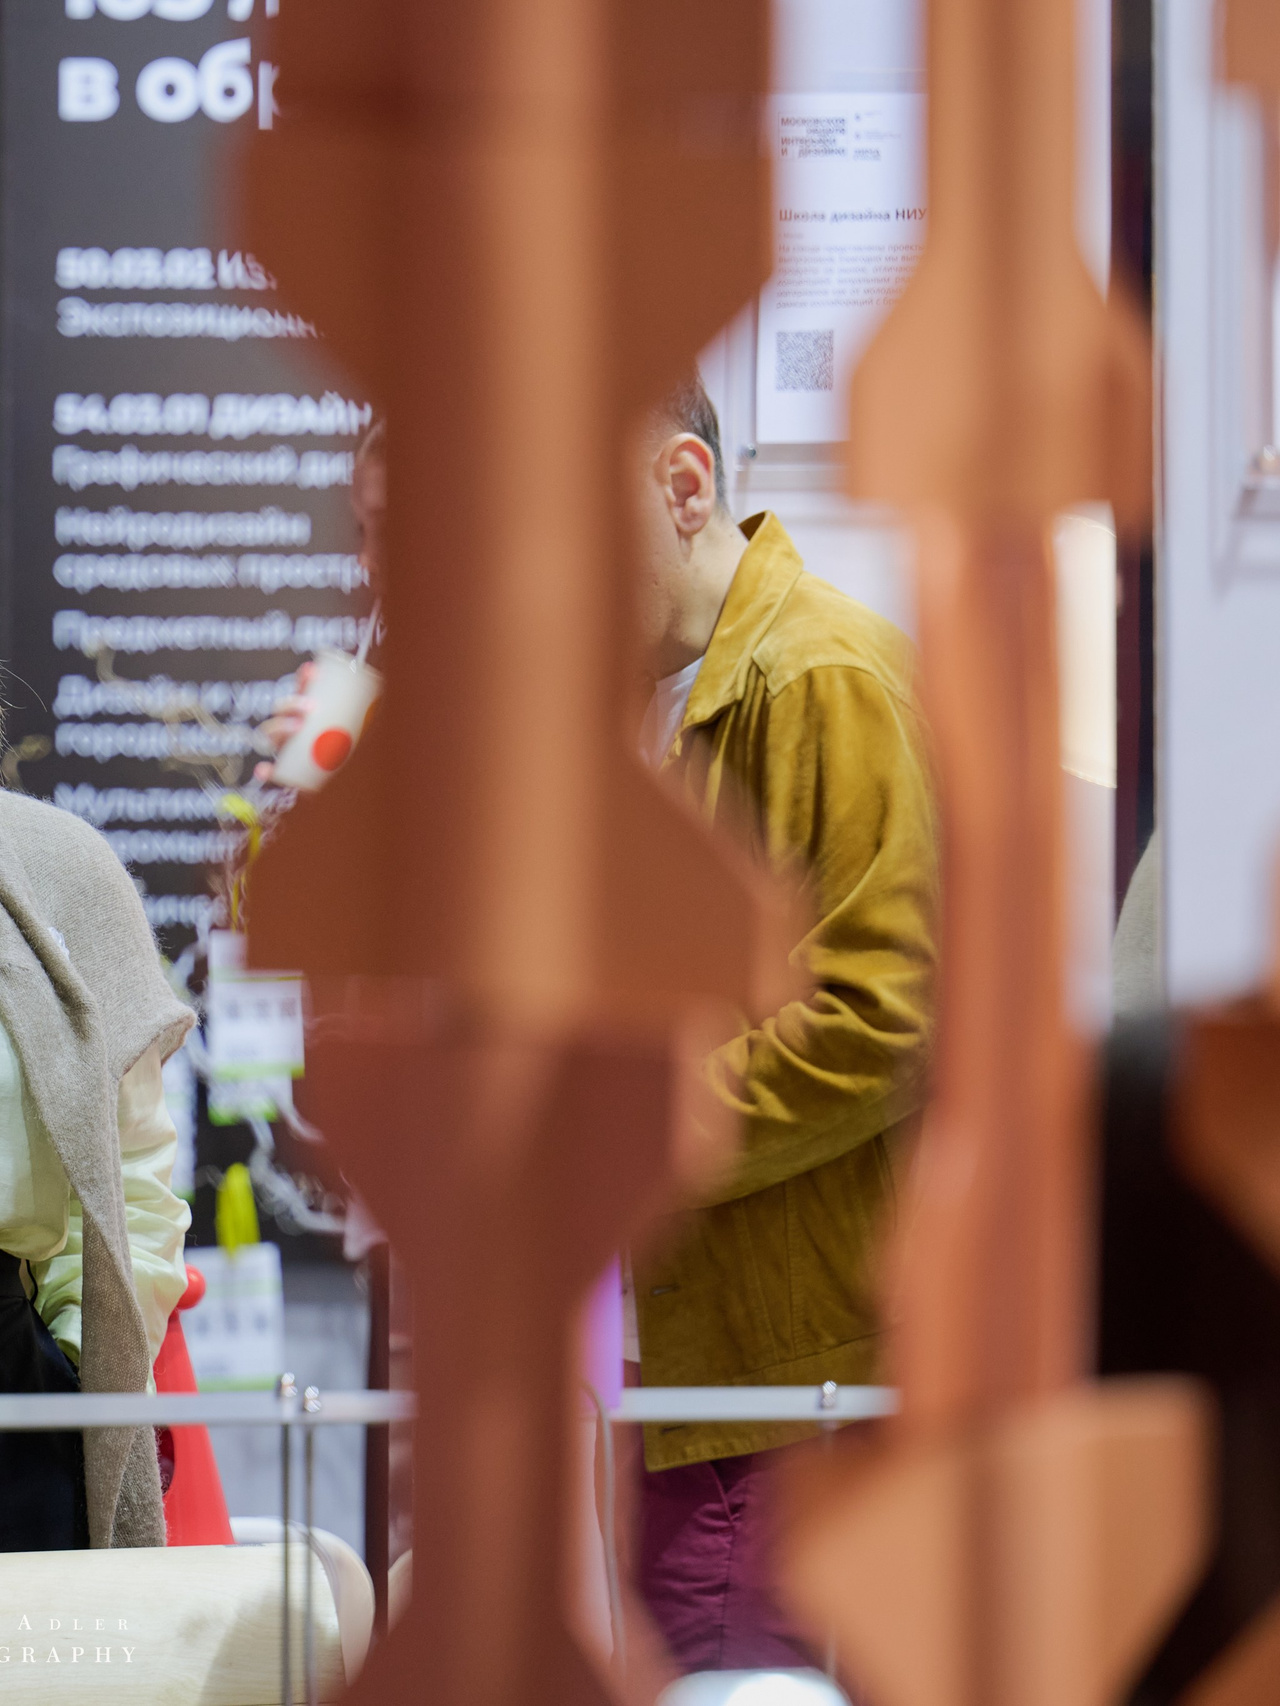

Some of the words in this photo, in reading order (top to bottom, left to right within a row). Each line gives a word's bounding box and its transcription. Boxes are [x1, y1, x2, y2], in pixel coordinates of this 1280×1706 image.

[58, 57, 120, 122] в
[778, 208, 826, 222] Школа
[830, 208, 891, 223] дизайна
[895, 207, 928, 221] НИУ
[53, 393, 209, 435] 54.03.01
[52, 444, 297, 491] Графический
[55, 506, 311, 551] Нейродизайн
[53, 554, 236, 594] средовых
[52, 610, 293, 654] Предметный
